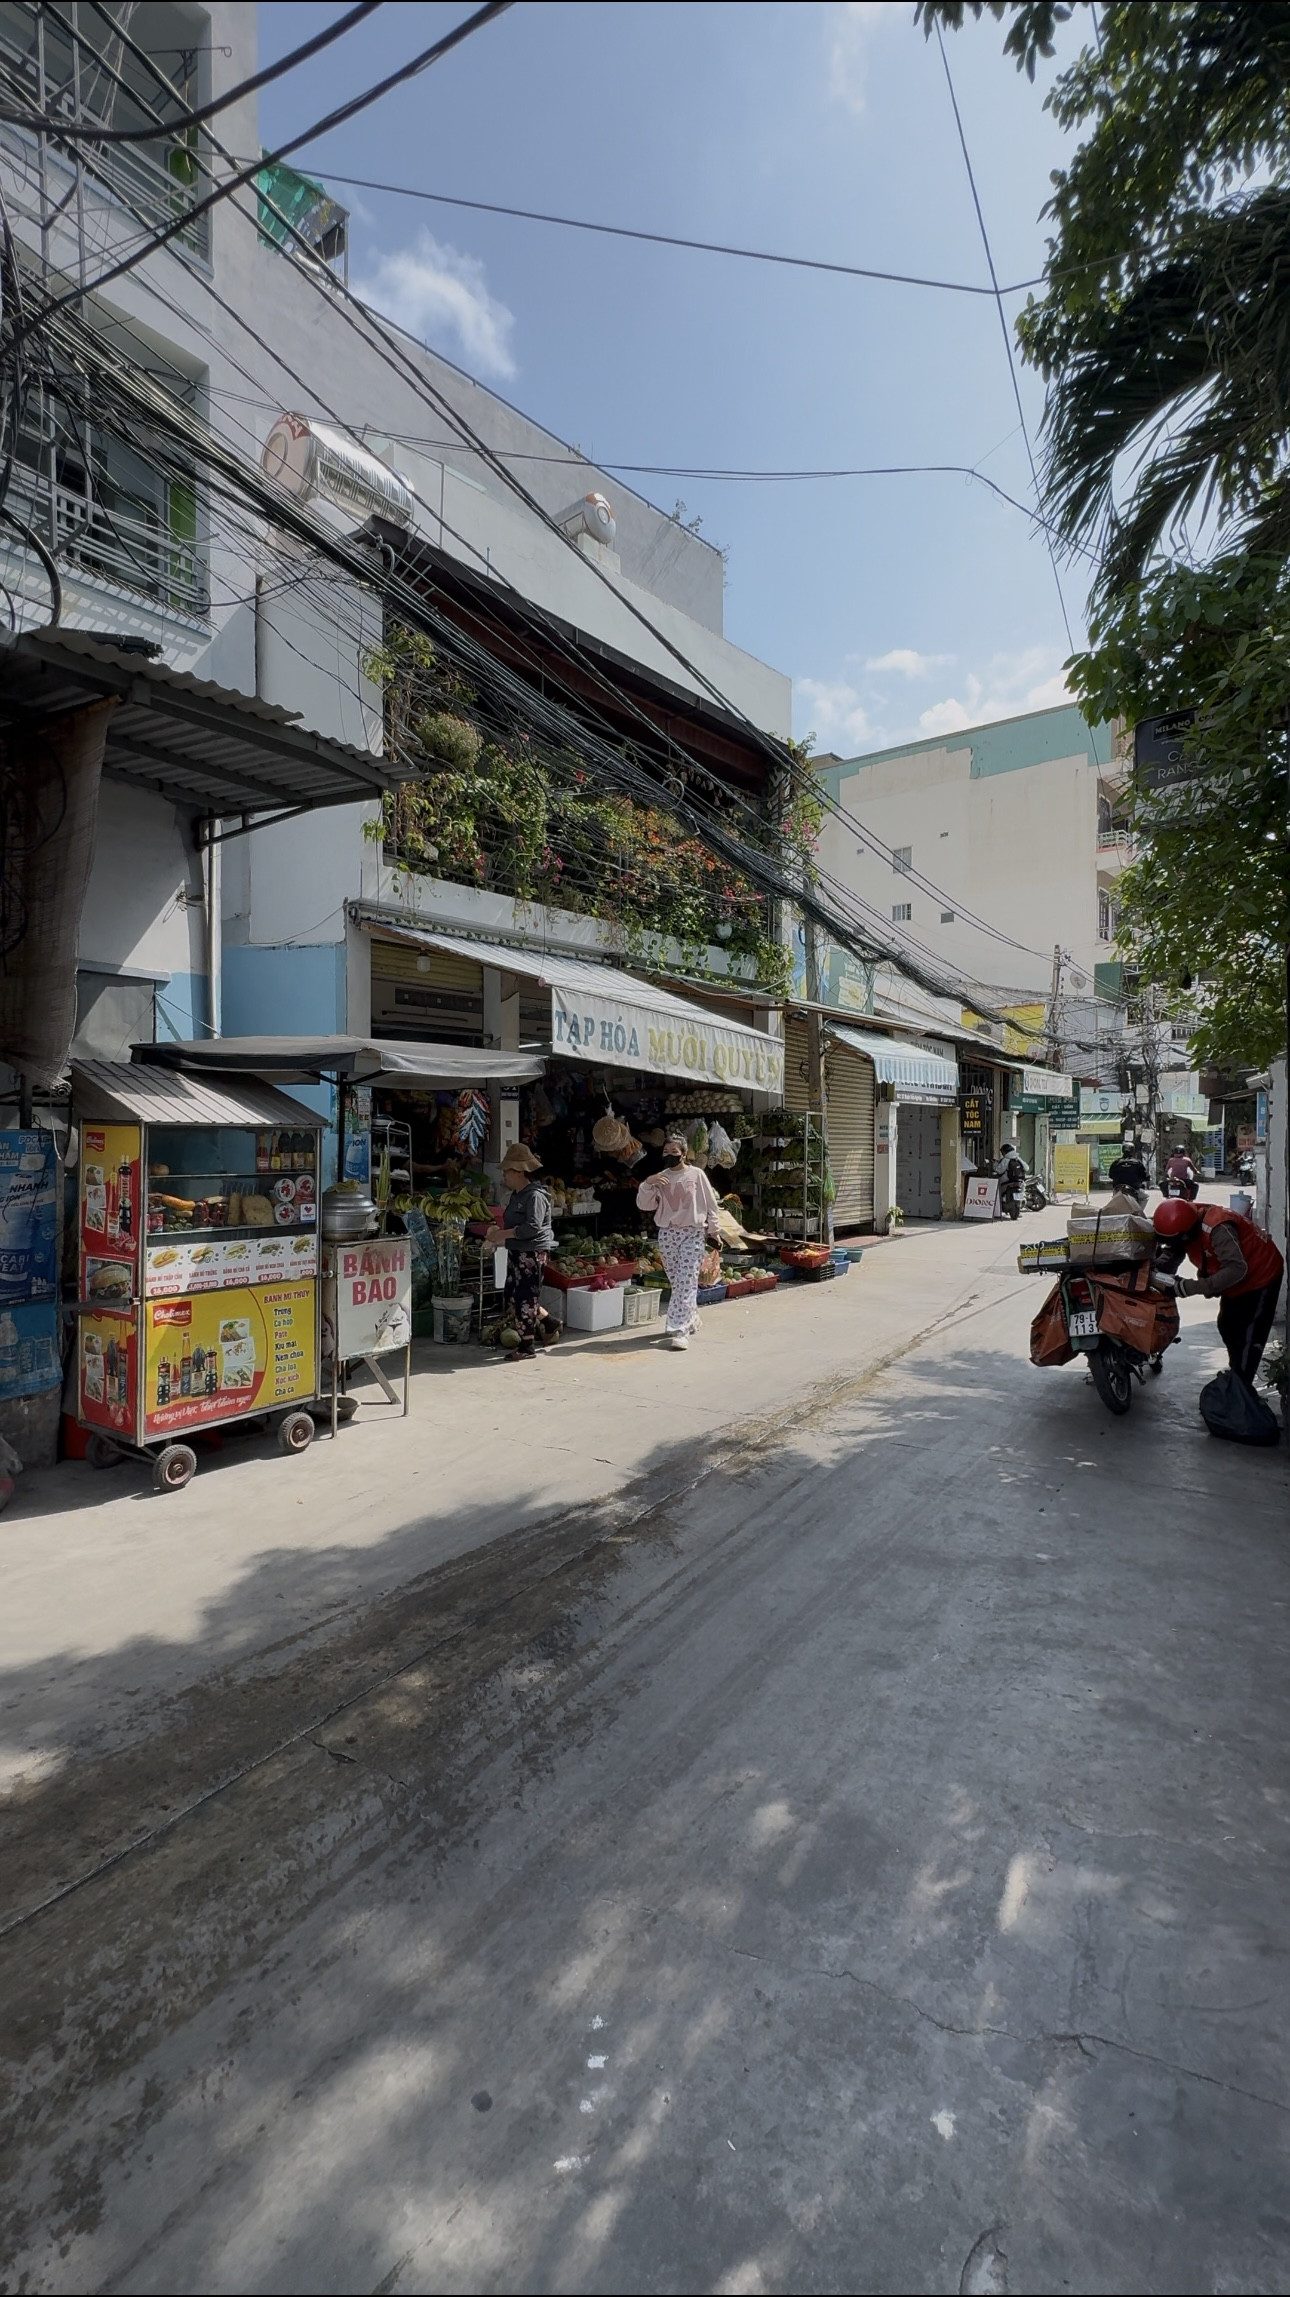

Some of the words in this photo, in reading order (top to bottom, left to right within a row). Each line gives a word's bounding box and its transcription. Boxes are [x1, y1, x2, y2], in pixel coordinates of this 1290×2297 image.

[1155, 719, 1191, 735] MILANO
[555, 1010, 595, 1051] TẠP
[600, 1016, 640, 1057] HÓA
[963, 1120, 981, 1128] NAM
[0, 1263, 24, 1272] EAT
[344, 1247, 405, 1279] BÁNH
[353, 1277, 397, 1306] BAO
[1074, 1313, 1097, 1324] 79-L
